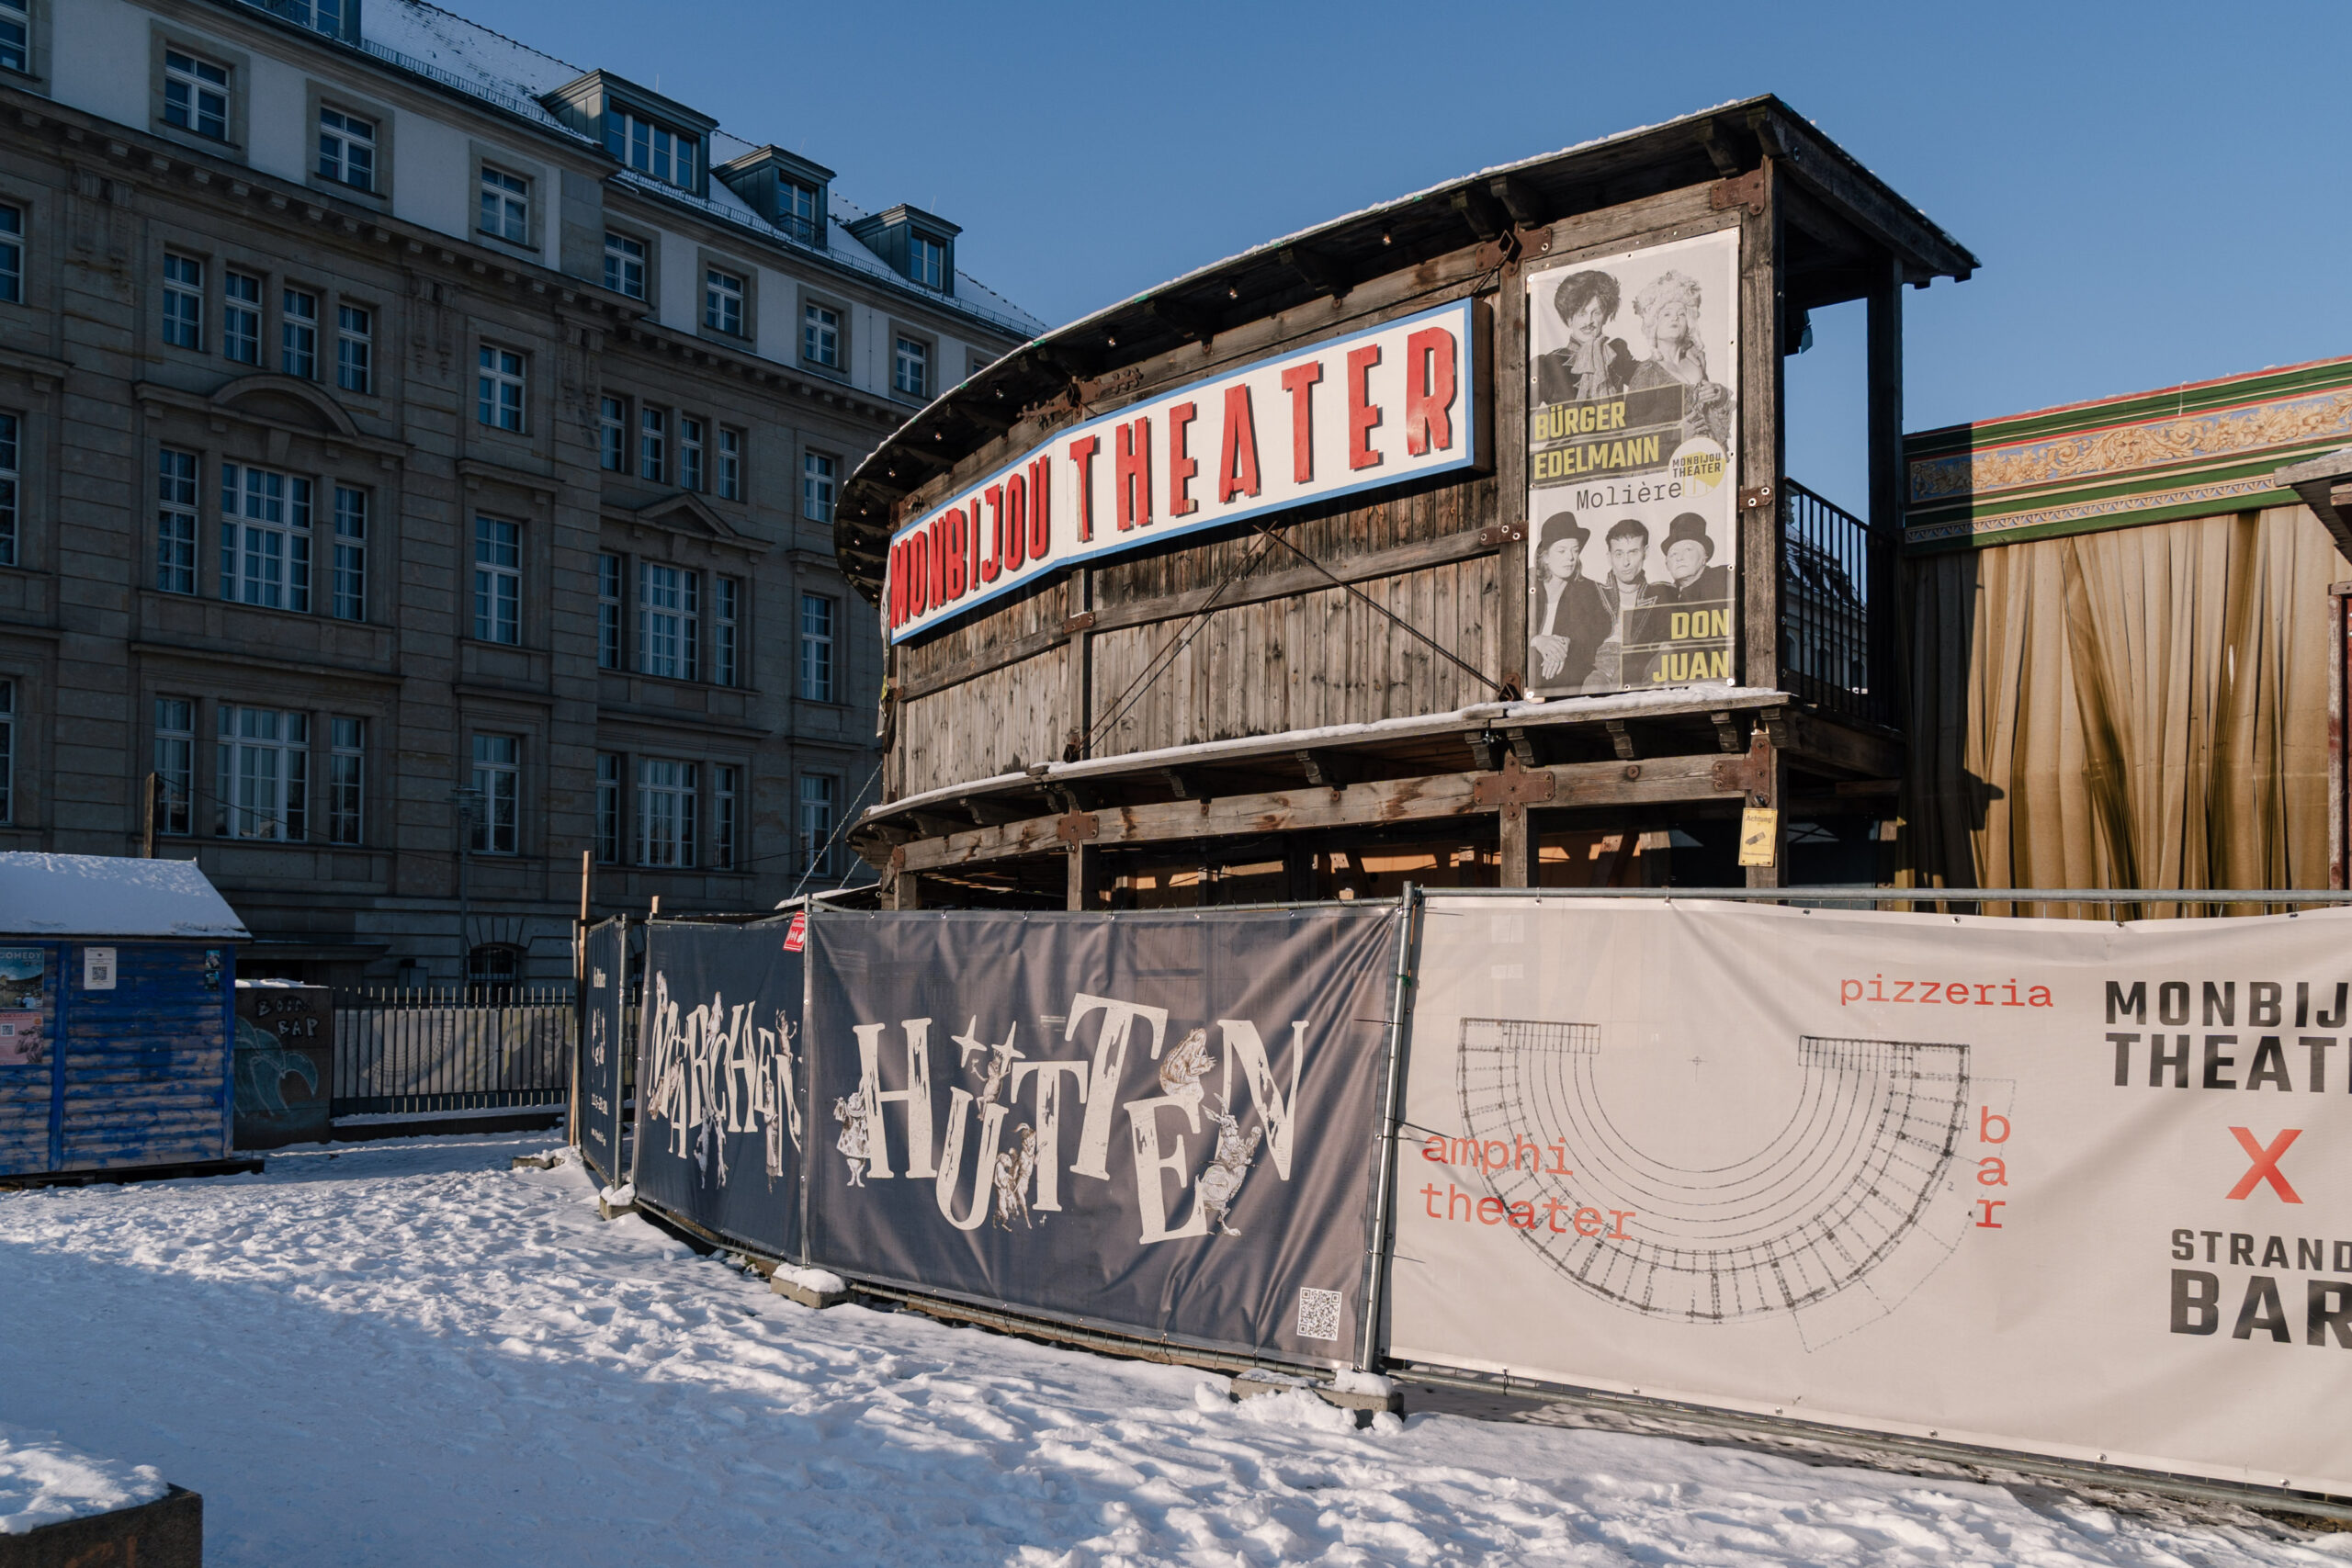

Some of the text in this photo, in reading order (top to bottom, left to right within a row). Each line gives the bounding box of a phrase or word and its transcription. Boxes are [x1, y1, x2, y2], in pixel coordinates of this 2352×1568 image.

[1534, 400, 1626, 441] BÜRGER
[889, 326, 1458, 630] MONBIJOU THEATER
[1533, 435, 1659, 480] EDELMANN
[1672, 453, 1722, 468] MONBIJOU
[1672, 462, 1722, 479] THEATER
[1577, 481, 1682, 511] Molière
[1671, 609, 1729, 639] DON
[1653, 650, 1729, 682] JUAN
[1840, 974, 2053, 1007] pizzeria
[2105, 980, 2349, 1028] MONBIJ
[277, 1017, 319, 1038] BAP
[2105, 1032, 2352, 1094] THEAT
[1421, 1134, 1574, 1176] amphi
[1975, 1105, 2011, 1229] bar
[2224, 1126, 2304, 1204] X
[1419, 1183, 1636, 1240] theater
[2170, 1269, 2352, 1349] BAR
